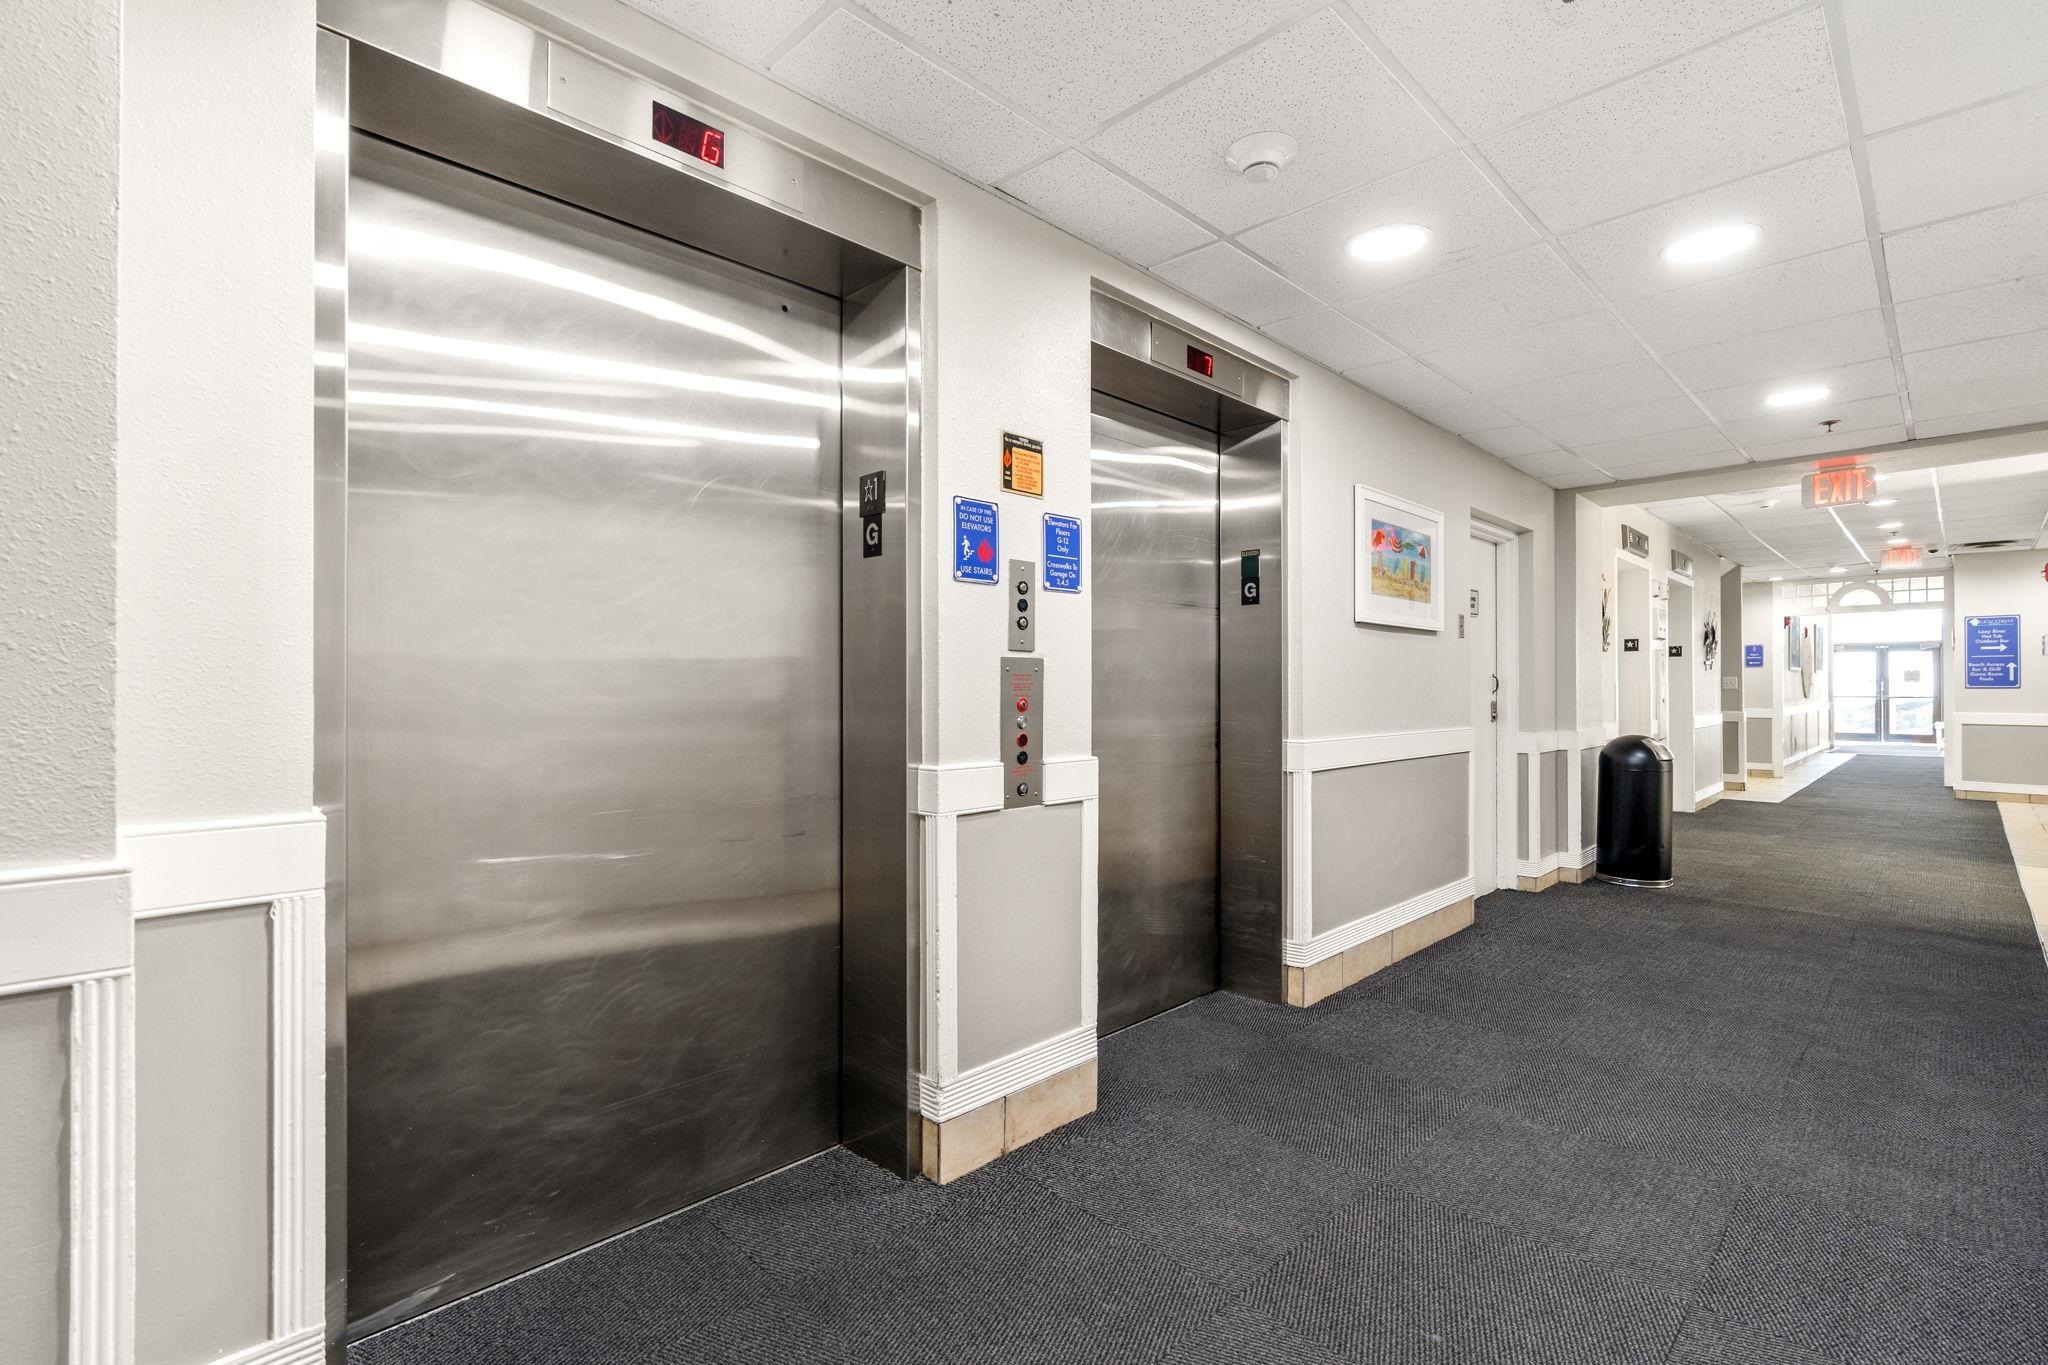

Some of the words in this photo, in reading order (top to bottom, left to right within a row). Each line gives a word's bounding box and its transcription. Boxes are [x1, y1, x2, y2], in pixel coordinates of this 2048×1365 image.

[701, 130, 721, 164] G
[1204, 355, 1212, 375] 7
[1813, 469, 1866, 504] EXIT
[970, 514, 982, 522] NOT
[983, 516, 994, 524] USE
[1048, 519, 1069, 528] Elevators
[961, 522, 992, 532] ELEVATORS
[1056, 528, 1070, 536] Floors
[866, 522, 879, 546] G
[1057, 545, 1069, 554] Only
[960, 565, 972, 574] USE
[974, 566, 992, 576] STAIRS
[1047, 561, 1072, 570] Crosswalks
[1050, 570, 1067, 578] Garage
[1056, 579, 1069, 587] 3,4,5
[1244, 582, 1256, 598] G
